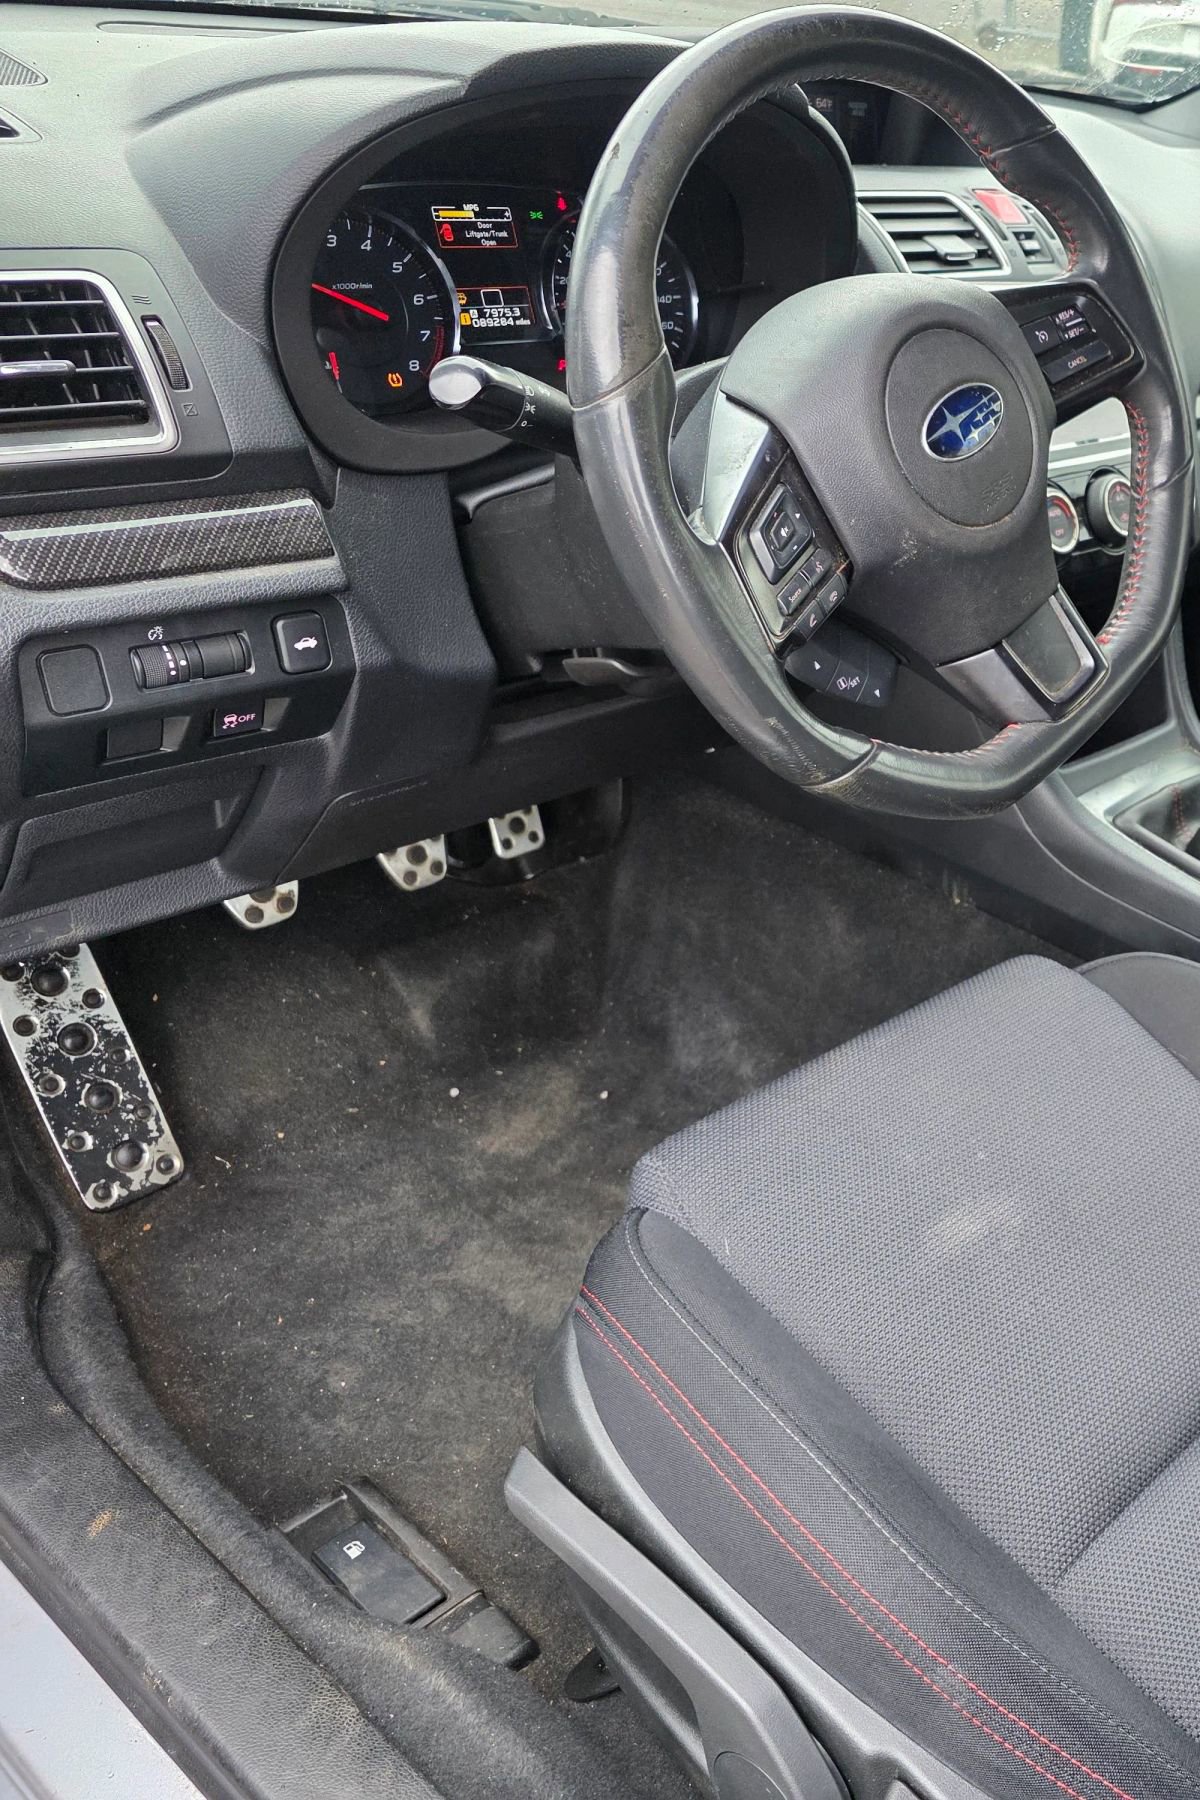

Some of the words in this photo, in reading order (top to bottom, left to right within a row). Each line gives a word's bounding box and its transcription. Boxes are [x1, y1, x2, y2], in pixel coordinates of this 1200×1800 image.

[463, 203, 479, 211] MPG
[465, 230, 509, 239] Liftgate/Trunk
[326, 234, 337, 247] 3
[360, 240, 372, 251] 4
[392, 261, 403, 273] 5
[413, 293, 424, 305] 6
[483, 307, 521, 318] 7975.3
[420, 330, 431, 341] 7
[408, 360, 420, 372] 8
[1067, 355, 1087, 369] CANCEL
[238, 713, 256, 723] OFF
